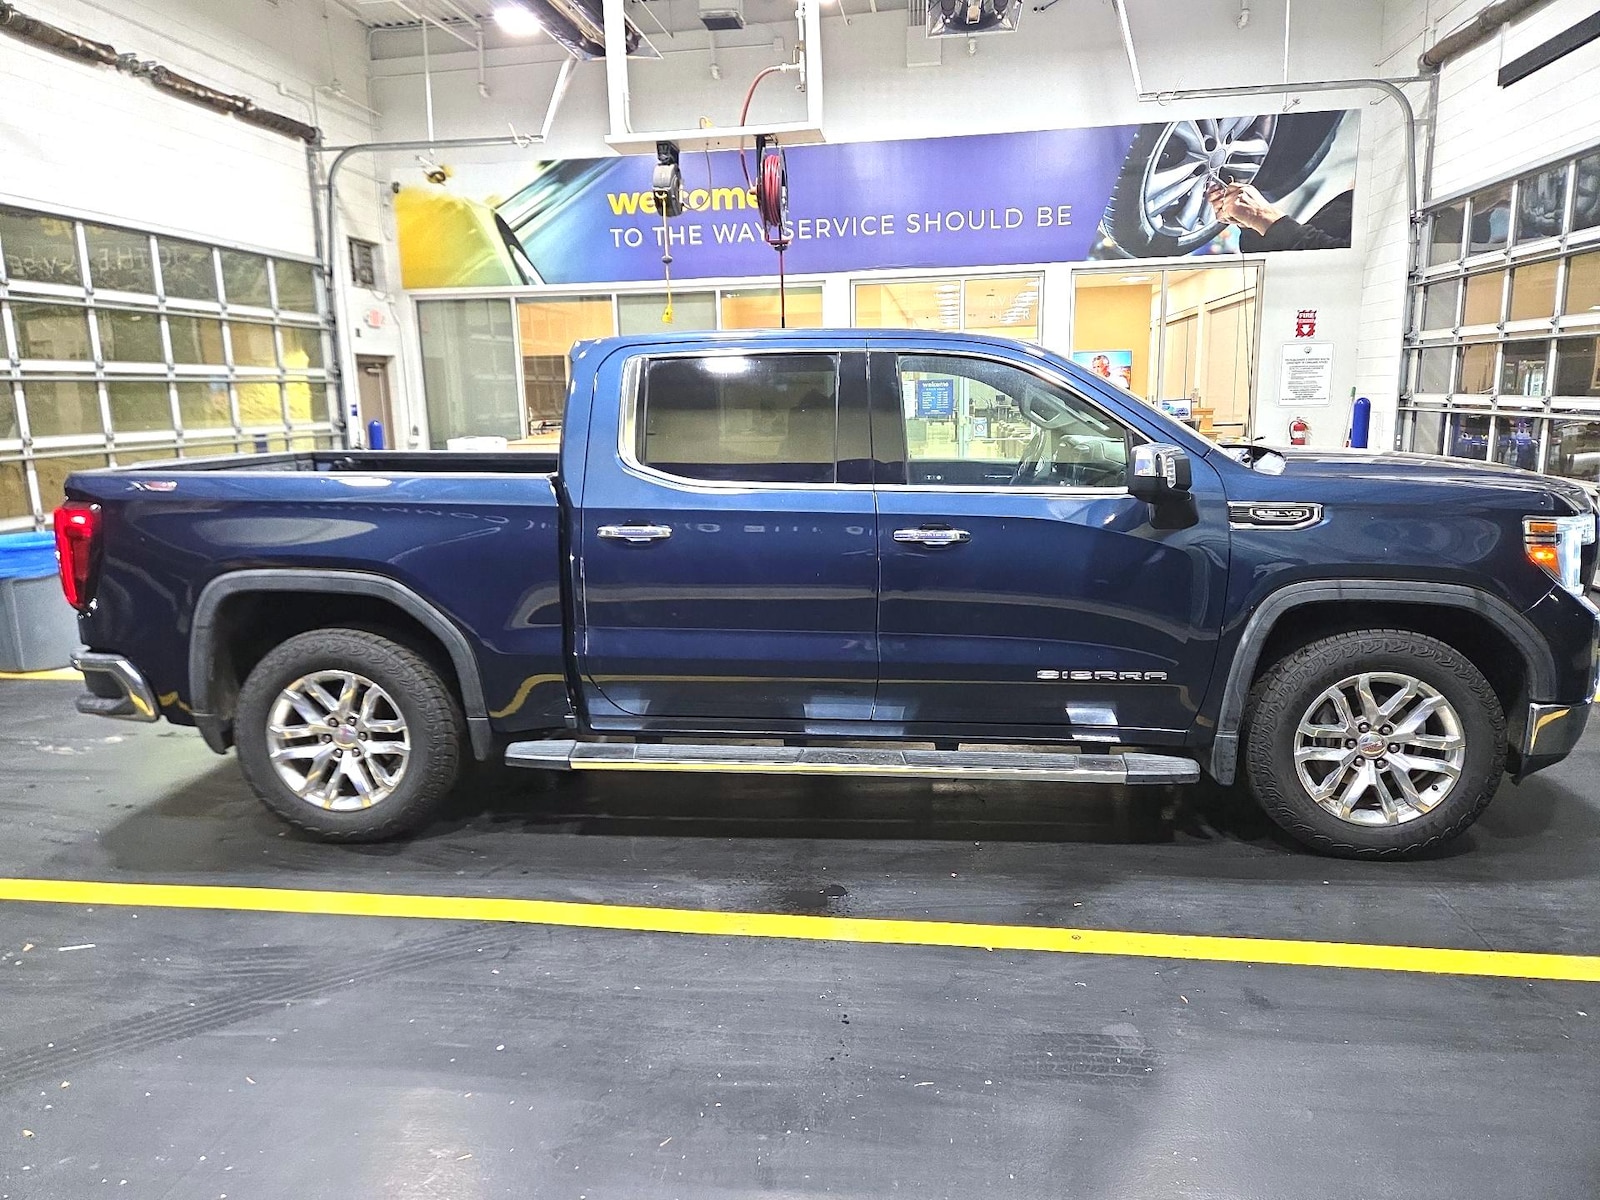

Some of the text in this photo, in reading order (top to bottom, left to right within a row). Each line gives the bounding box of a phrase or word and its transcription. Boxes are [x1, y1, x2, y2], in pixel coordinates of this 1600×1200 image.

[607, 187, 759, 215] weome
[609, 227, 643, 248] TO
[652, 224, 703, 247] THE
[782, 213, 895, 240] SERVICE
[906, 207, 1024, 234] SHOULD
[1036, 205, 1073, 227] BE
[1036, 670, 1168, 681] SIERRA
